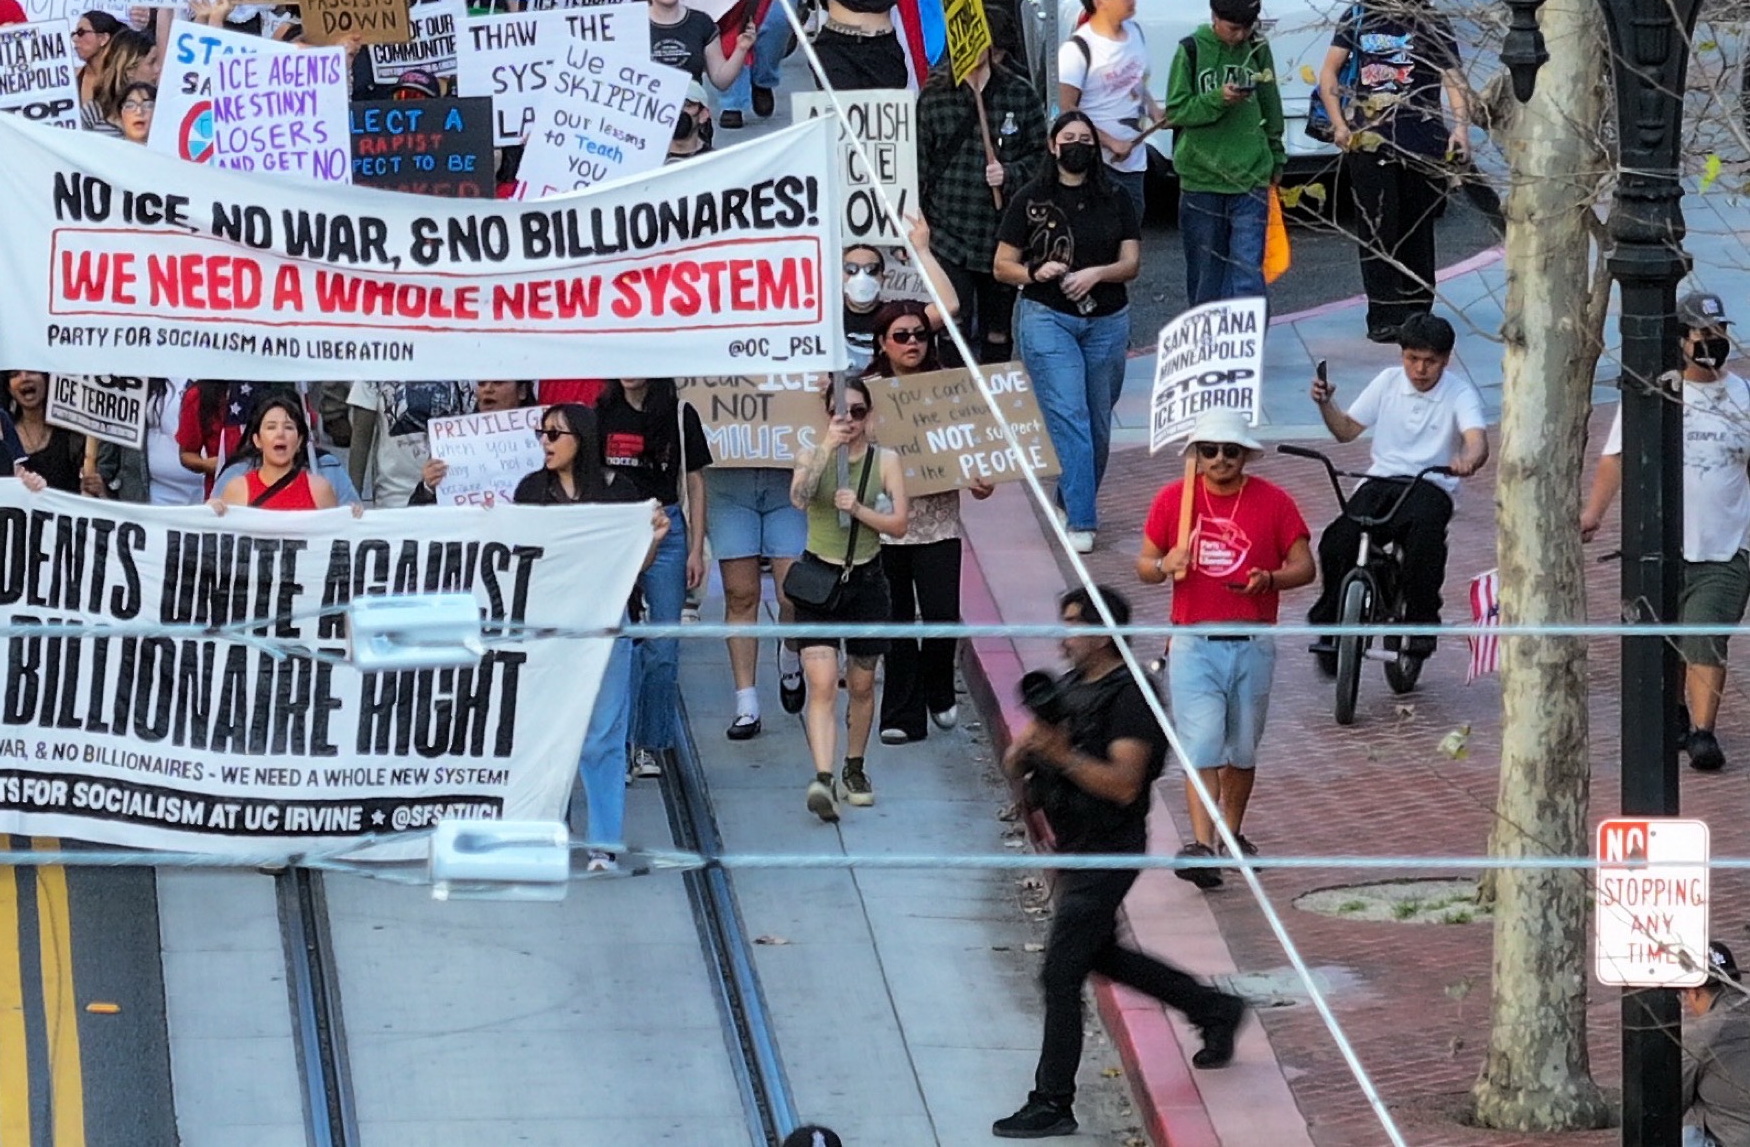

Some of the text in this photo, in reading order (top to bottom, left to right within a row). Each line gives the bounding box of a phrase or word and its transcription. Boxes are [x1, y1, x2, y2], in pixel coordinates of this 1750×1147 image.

[323, 10, 397, 35] DOWN
[469, 13, 615, 51] THAW THE
[30, 33, 66, 62] ANA
[219, 53, 340, 91] ICE AGENTS
[554, 71, 677, 128] SKIPPING
[216, 120, 328, 154] LOSERS
[575, 133, 623, 164] Teach
[53, 172, 112, 221] NO
[123, 191, 198, 233] ICE,
[212, 201, 273, 250] NO
[281, 208, 401, 271] WAR,
[520, 175, 819, 259] BILLIONARES!
[61, 251, 816, 322] WE NEED A WHOLE NEW SYSTEM!
[48, 324, 414, 362] PARTY FOR SOCIALISM AND LIBERATION
[728, 334, 826, 361] @OC_PSL
[1160, 339, 1256, 382] MINNEAPOLIS
[54, 377, 140, 425] ICE TERROR
[1156, 369, 1254, 408] STOP
[926, 423, 975, 454] NOT
[161, 531, 307, 639] UNITE
[317, 539, 544, 643] AGAINST
[3, 615, 342, 757] BILLIONAIRE
[35, 741, 47, 760] &
[52, 743, 79, 761] NO
[82, 744, 204, 781] BILLIONAIRES
[220, 766, 250, 785] WE
[254, 767, 301, 787] NEED
[307, 767, 319, 787] A
[324, 767, 386, 786] WHOLE
[390, 767, 430, 786] NEW
[433, 766, 509, 786] SYSTEM!
[22, 778, 69, 806] FOR
[71, 781, 204, 826] SOCIALISM
[208, 805, 241, 830] AT
[244, 805, 280, 831] UC
[284, 806, 363, 831] IRVINE
[1606, 827, 1645, 863] NO
[1604, 877, 1704, 907] STOPPING
[1630, 914, 1674, 934] ANY
[1627, 942, 1678, 965] TIME
